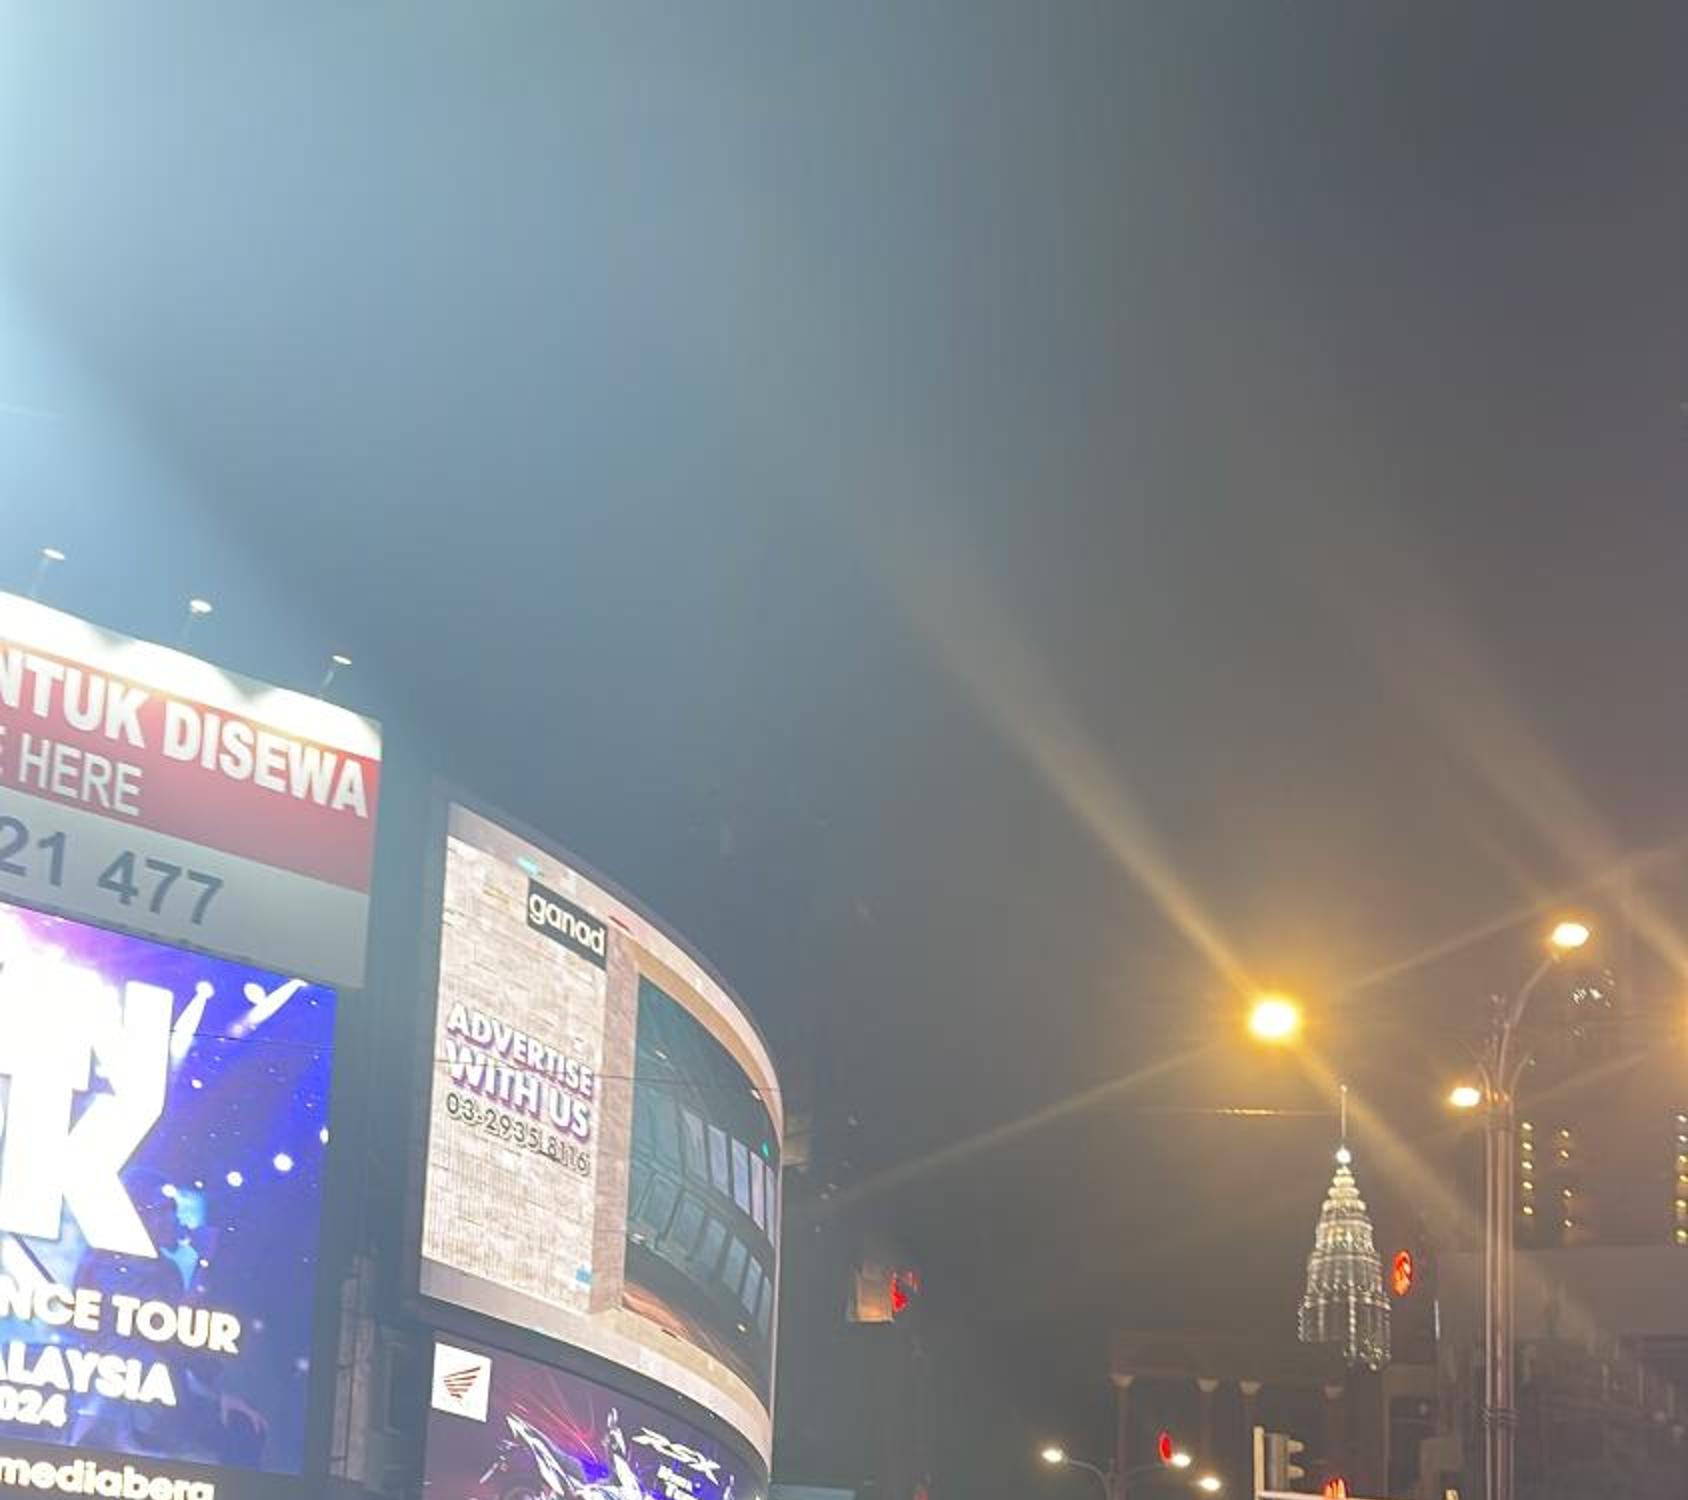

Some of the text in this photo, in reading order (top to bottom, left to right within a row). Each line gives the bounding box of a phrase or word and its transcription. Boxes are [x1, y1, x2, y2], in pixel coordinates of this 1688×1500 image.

[18, 732, 144, 817] HERE
[162, 697, 369, 820] DISEWA
[97, 850, 225, 926] 477
[445, 1038, 592, 1143] WITH US
[446, 1001, 595, 1101] ADVERTISE
[111, 1295, 241, 1354] TOUR
